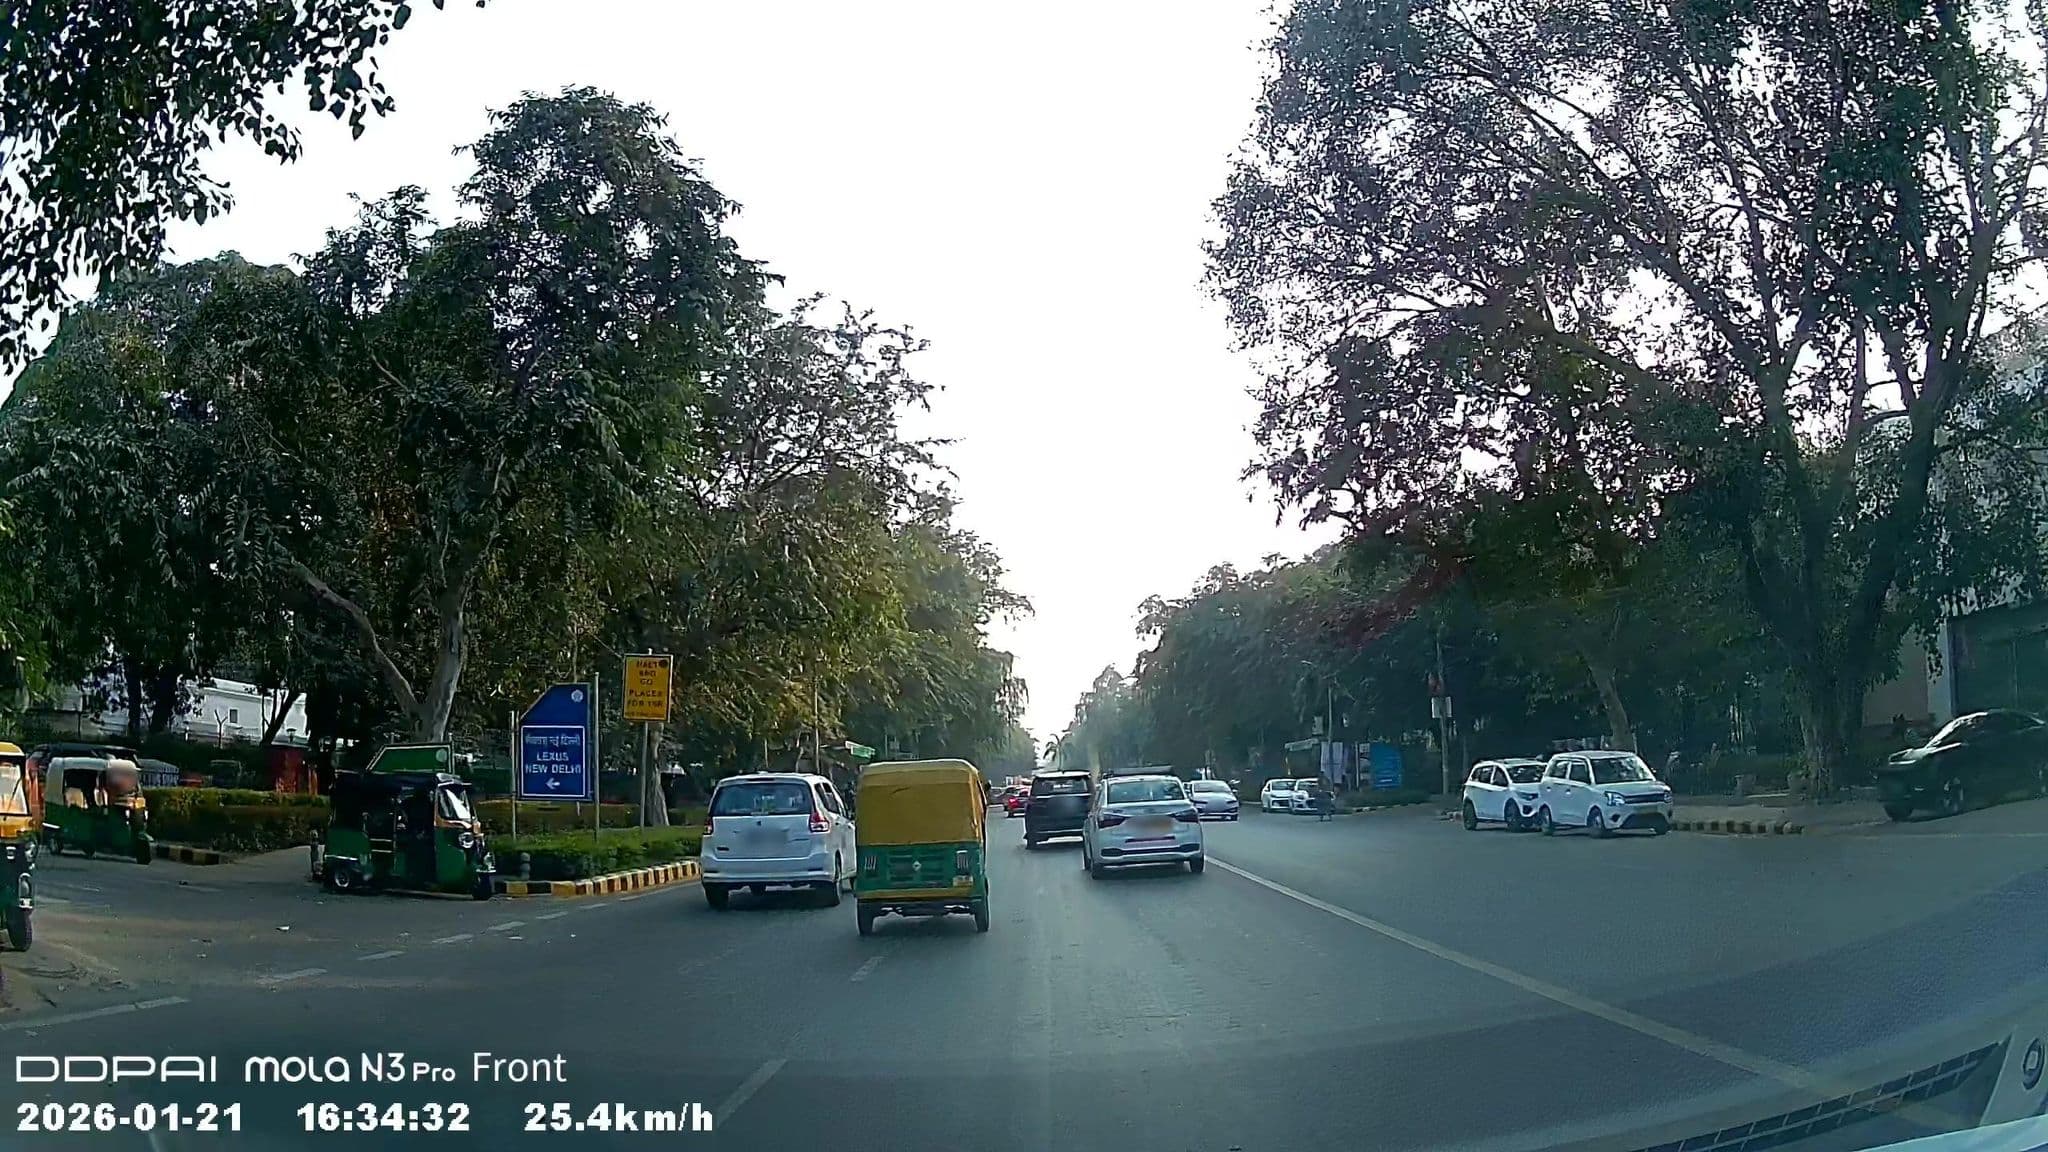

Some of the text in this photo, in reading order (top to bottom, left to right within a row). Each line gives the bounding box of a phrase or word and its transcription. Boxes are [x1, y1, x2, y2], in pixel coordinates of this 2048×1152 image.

[536, 751, 569, 761] LEXUS
[525, 763, 581, 774] NEW DELHI
